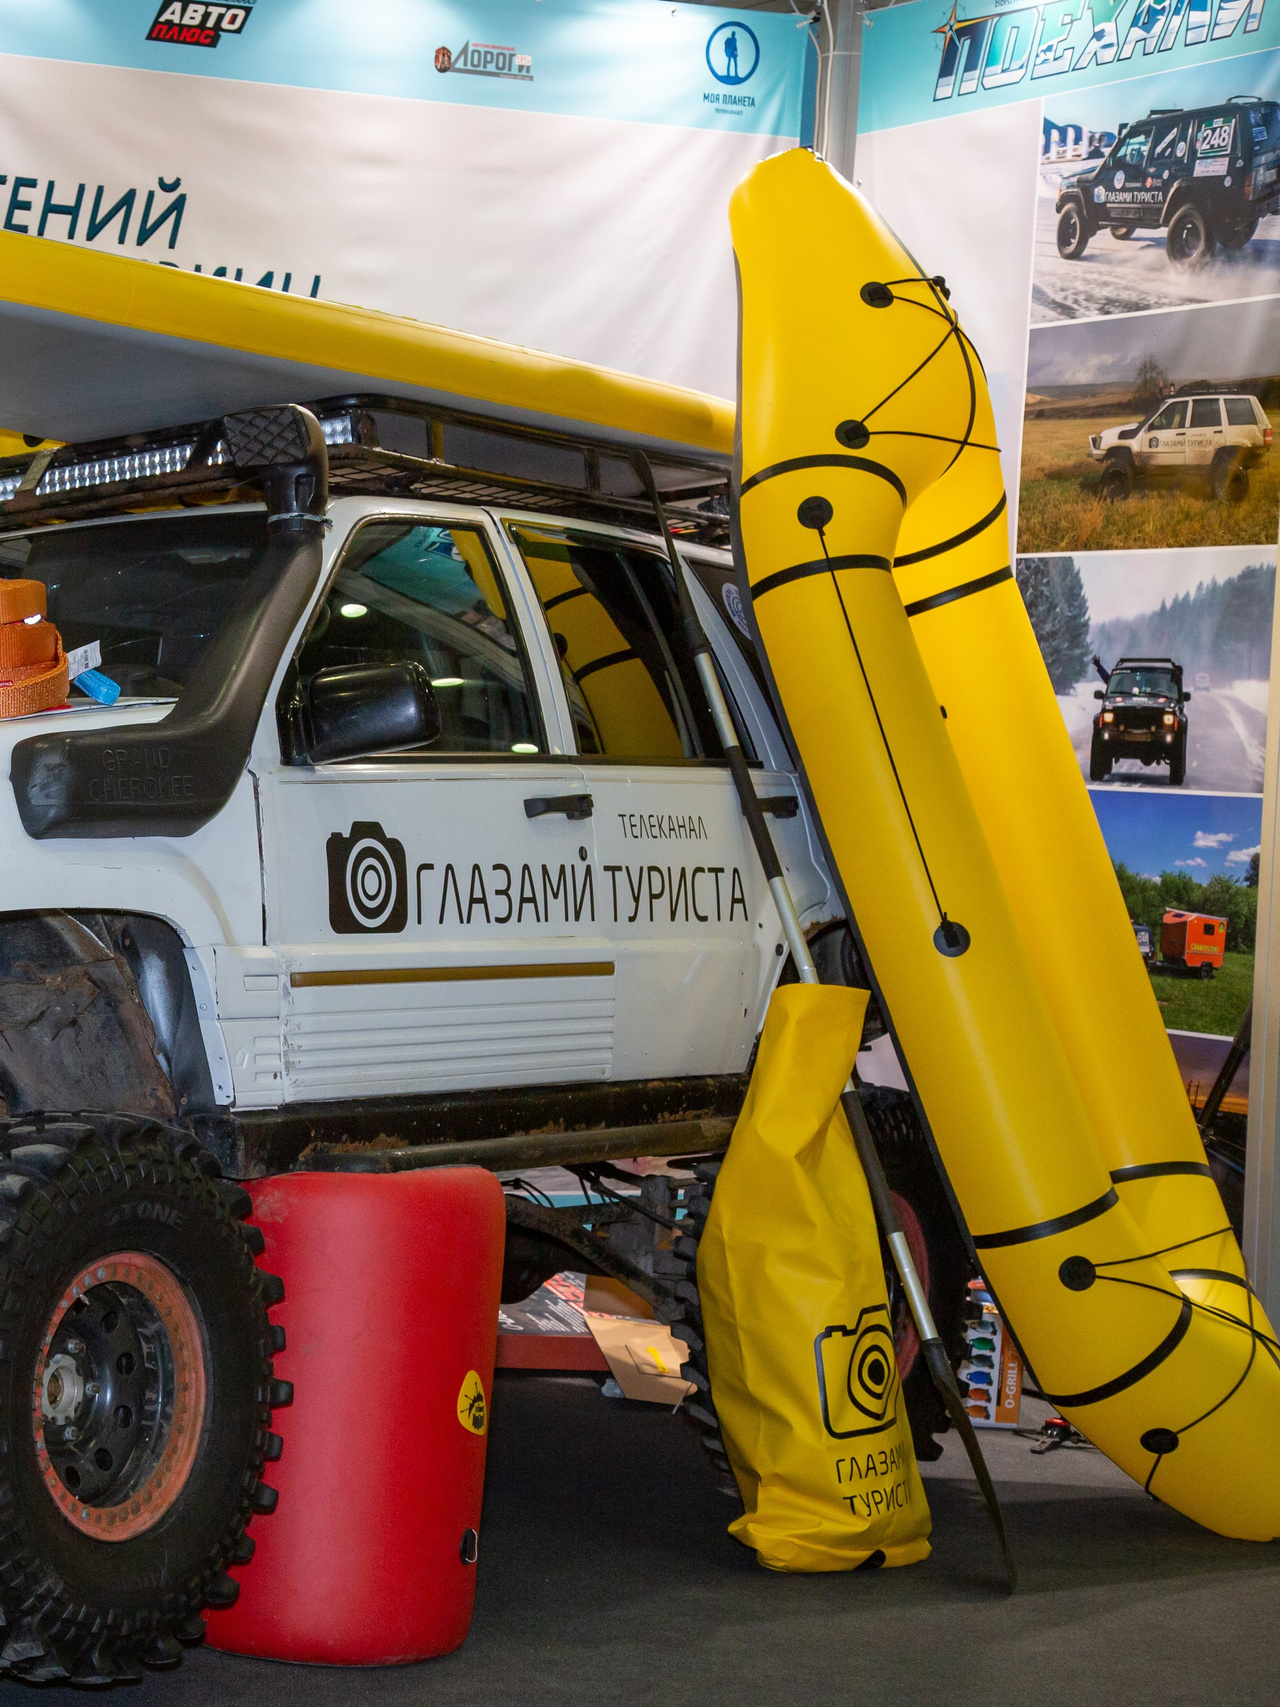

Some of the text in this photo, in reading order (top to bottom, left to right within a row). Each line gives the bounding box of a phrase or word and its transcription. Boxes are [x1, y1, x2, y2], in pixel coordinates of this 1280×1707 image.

[158, 1, 246, 31] АВТО
[151, 24, 215, 44] ПЛЮС
[703, 92, 756, 107] МОЯ ПЛАНЕТА
[1201, 126, 1231, 150] 248
[1105, 191, 1163, 203] ГЛАЗАМИ ТУРИСТА
[88, 774, 194, 801] CHEROKEE
[617, 814, 708, 840] ТЕЛЕКАНАЛ
[416, 862, 749, 925] ГЛАЗАМИ ТУРИСТА
[1004, 1361, 1019, 1409] O-GRILL
[843, 1480, 908, 1517] ТУРИСТ
